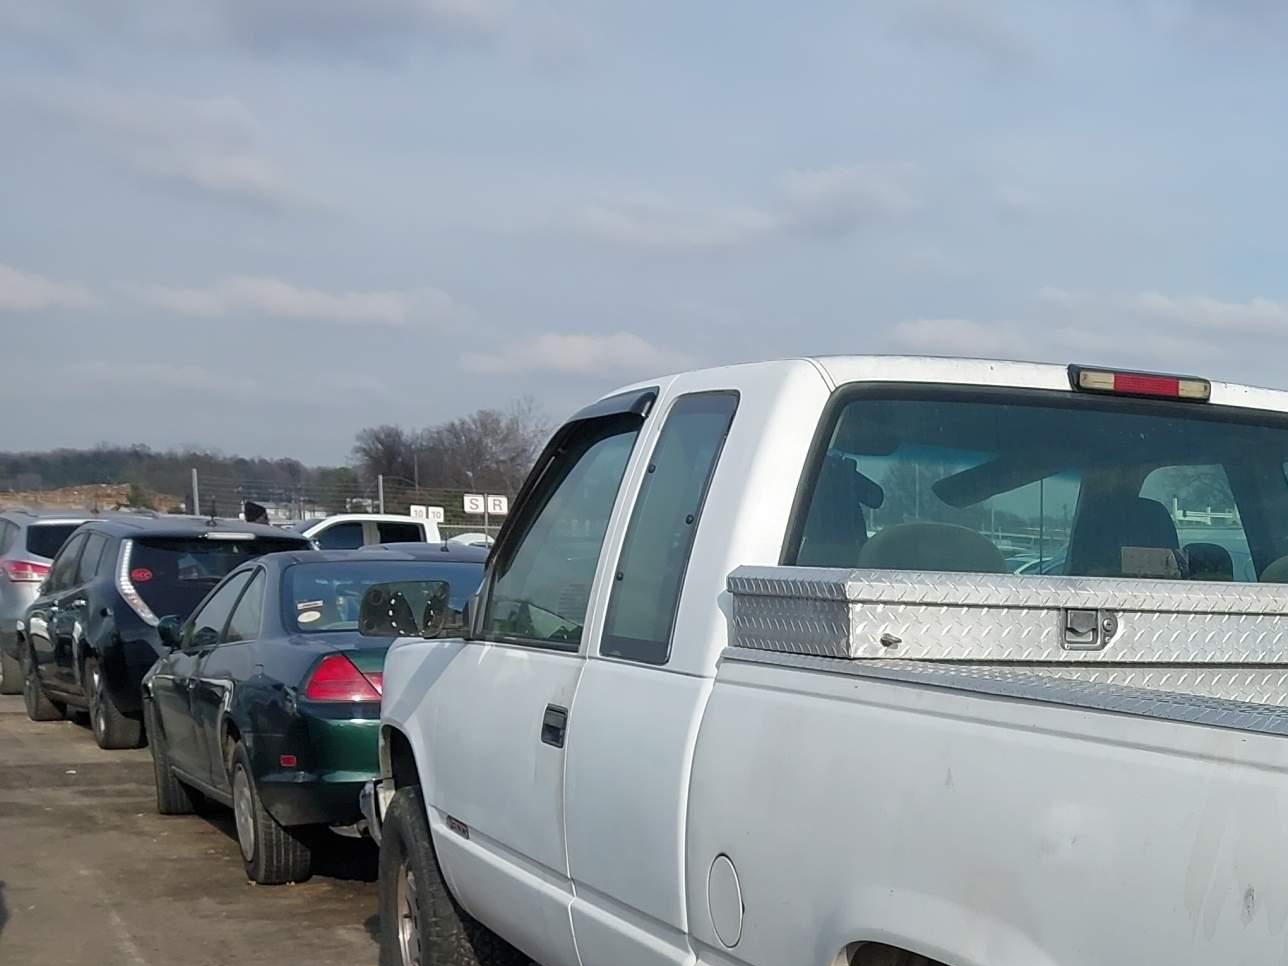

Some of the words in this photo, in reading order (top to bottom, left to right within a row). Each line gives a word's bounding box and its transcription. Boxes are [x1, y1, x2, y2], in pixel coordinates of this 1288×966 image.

[469, 498, 480, 511] S
[492, 499, 503, 512] R
[431, 511, 442, 520] 10
